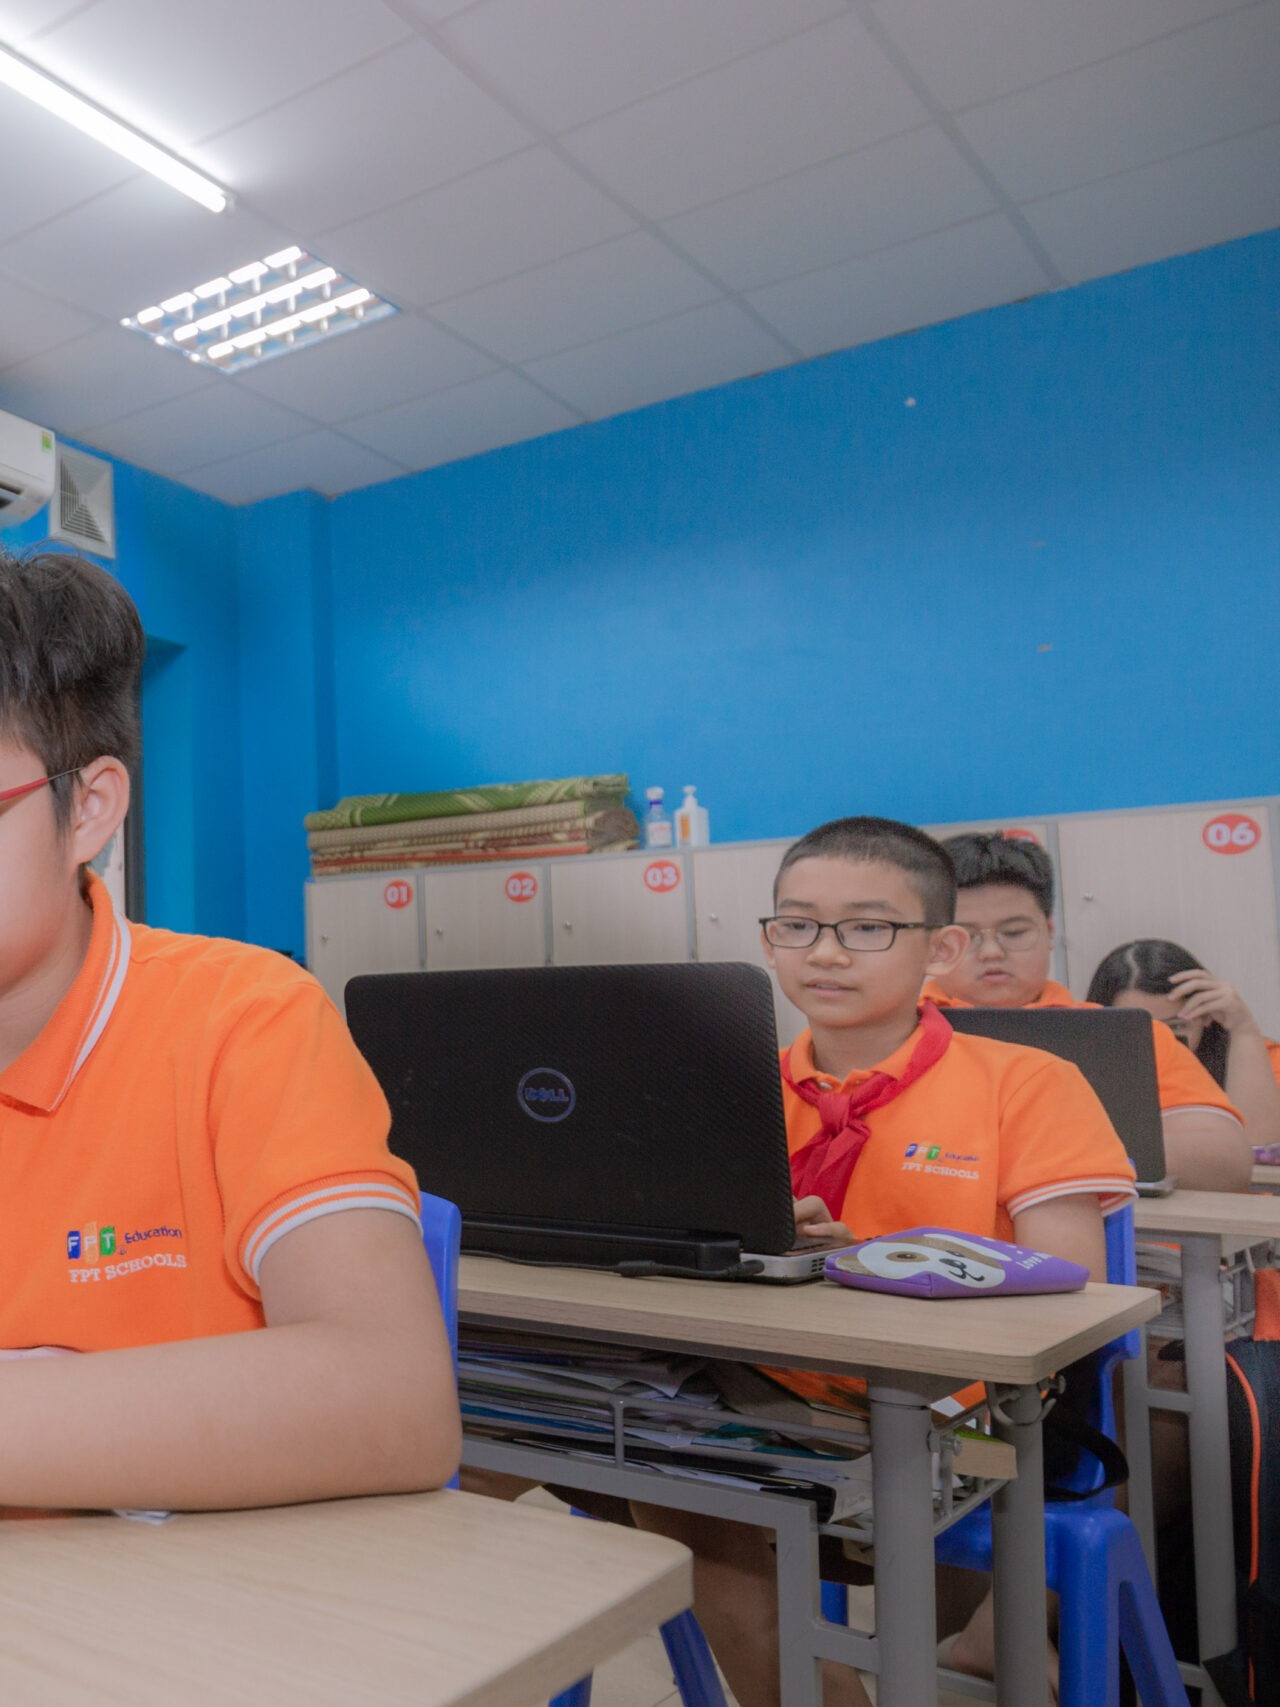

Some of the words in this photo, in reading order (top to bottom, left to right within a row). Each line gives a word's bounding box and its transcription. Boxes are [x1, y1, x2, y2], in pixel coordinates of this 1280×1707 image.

[1208, 822, 1256, 846] 06
[647, 866, 677, 887] 03
[385, 885, 408, 903] 01
[507, 878, 534, 897] 02
[525, 1087, 569, 1102] DELL
[901, 1161, 923, 1172] FPT
[924, 1163, 979, 1180] SCHOOLS
[67, 1226, 116, 1258] FPT
[124, 1225, 183, 1244] Education
[68, 1267, 101, 1283] FPT
[104, 1253, 187, 1281] SCHOOLS
